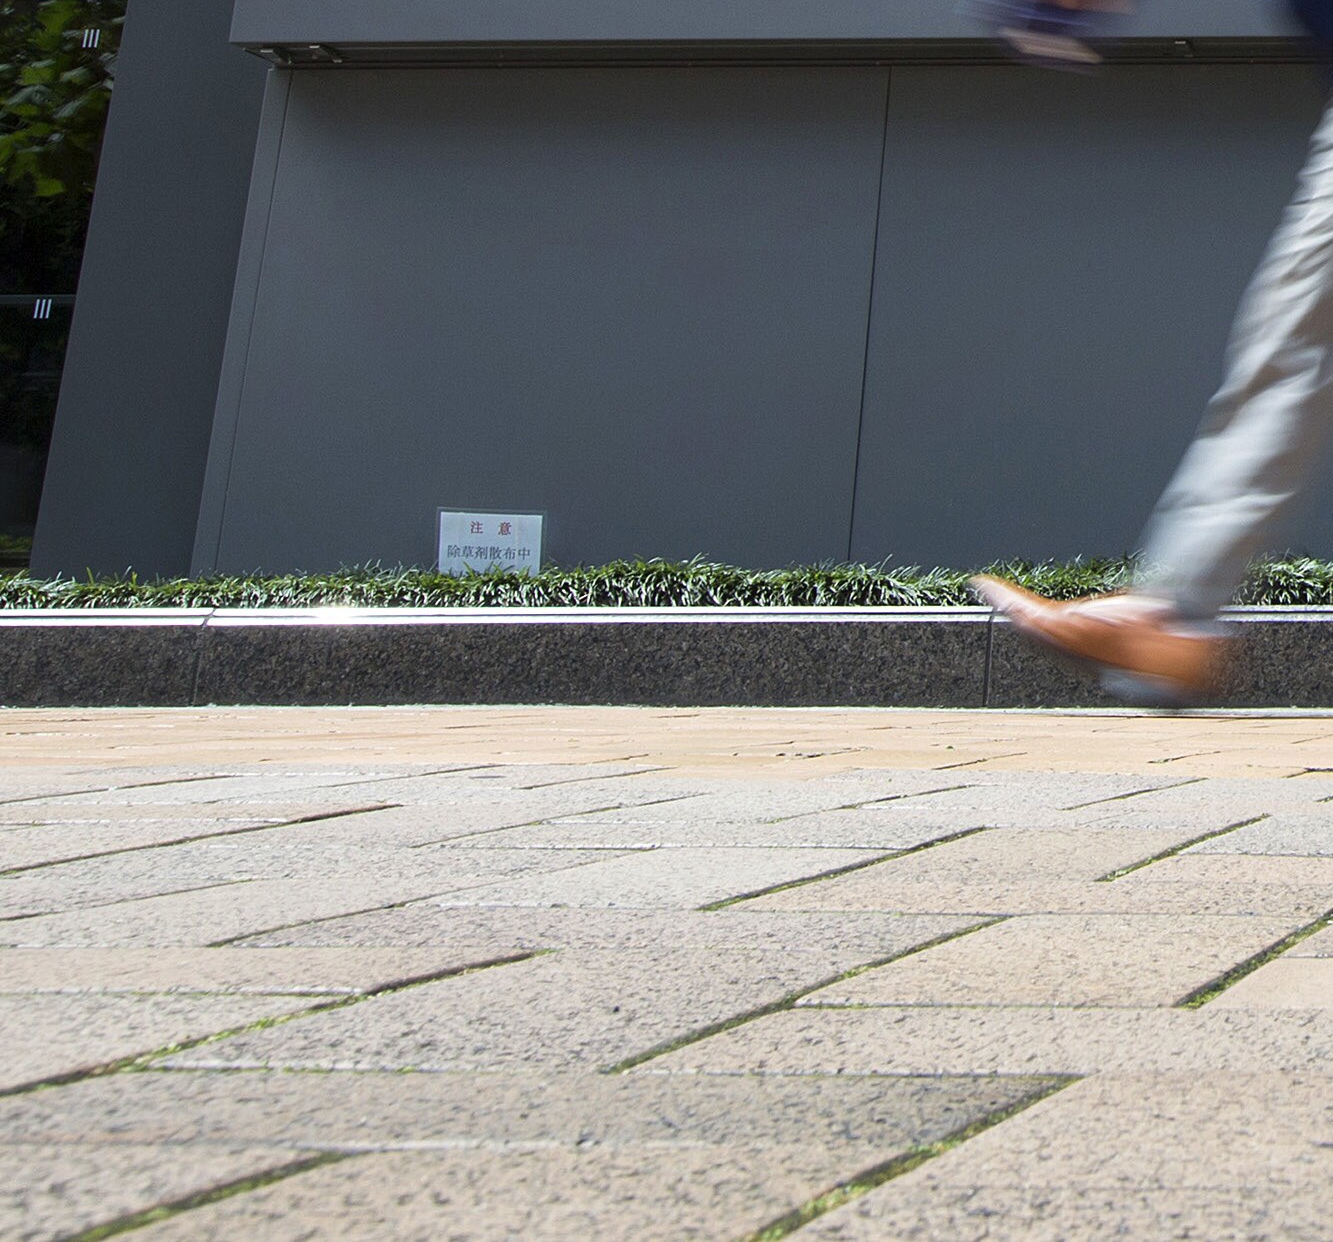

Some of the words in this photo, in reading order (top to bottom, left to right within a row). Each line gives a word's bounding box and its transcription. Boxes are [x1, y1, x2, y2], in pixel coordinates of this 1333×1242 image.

[470, 521, 511, 535] 注意
[447, 544, 531, 561] 除草剤散布中
